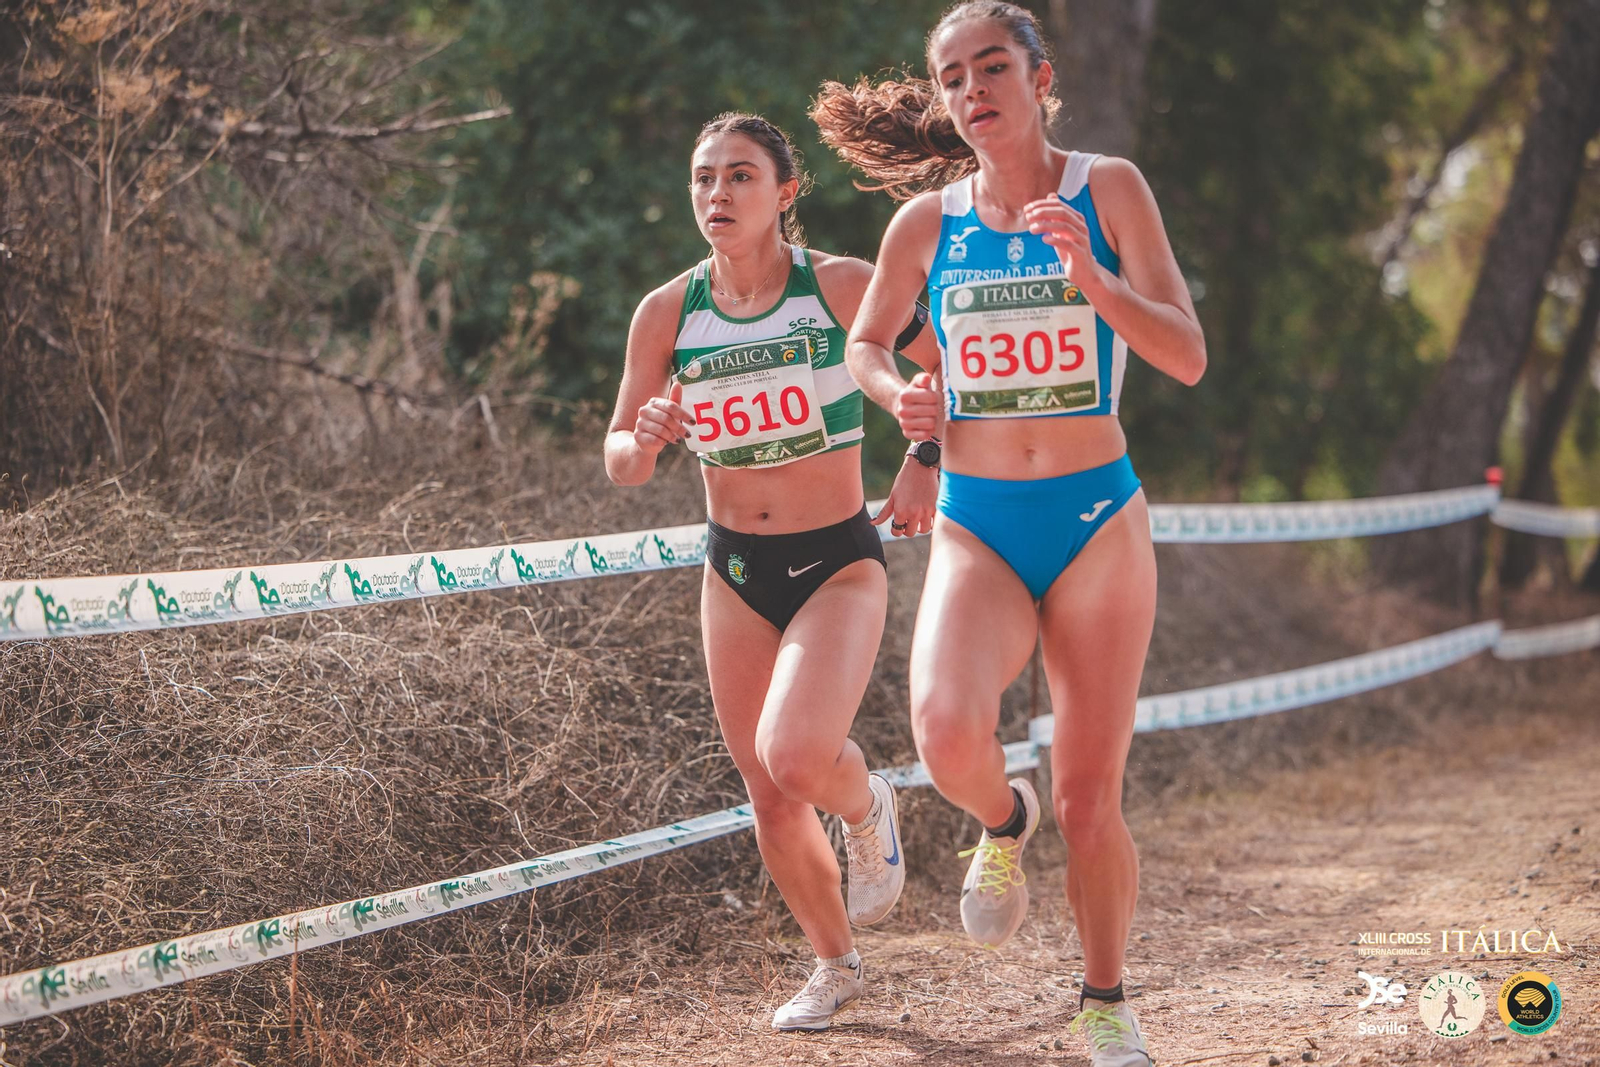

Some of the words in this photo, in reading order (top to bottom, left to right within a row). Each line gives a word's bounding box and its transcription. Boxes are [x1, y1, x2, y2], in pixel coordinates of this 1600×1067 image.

[940, 268, 1021, 285] UNIVERSIDAD
[1026, 265, 1043, 276] DE
[983, 283, 1054, 303] ITÁLICA
[788, 317, 817, 330] SCP
[709, 348, 773, 371] ITÁLICA
[960, 327, 1085, 379] 6305
[693, 385, 810, 443] 5610
[461, 876, 492, 897] Sevilla
[375, 898, 409, 919] Sevilla
[282, 920, 319, 943] Sevilla
[181, 948, 219, 968] Sevilla
[69, 970, 111, 995] Sevilla
